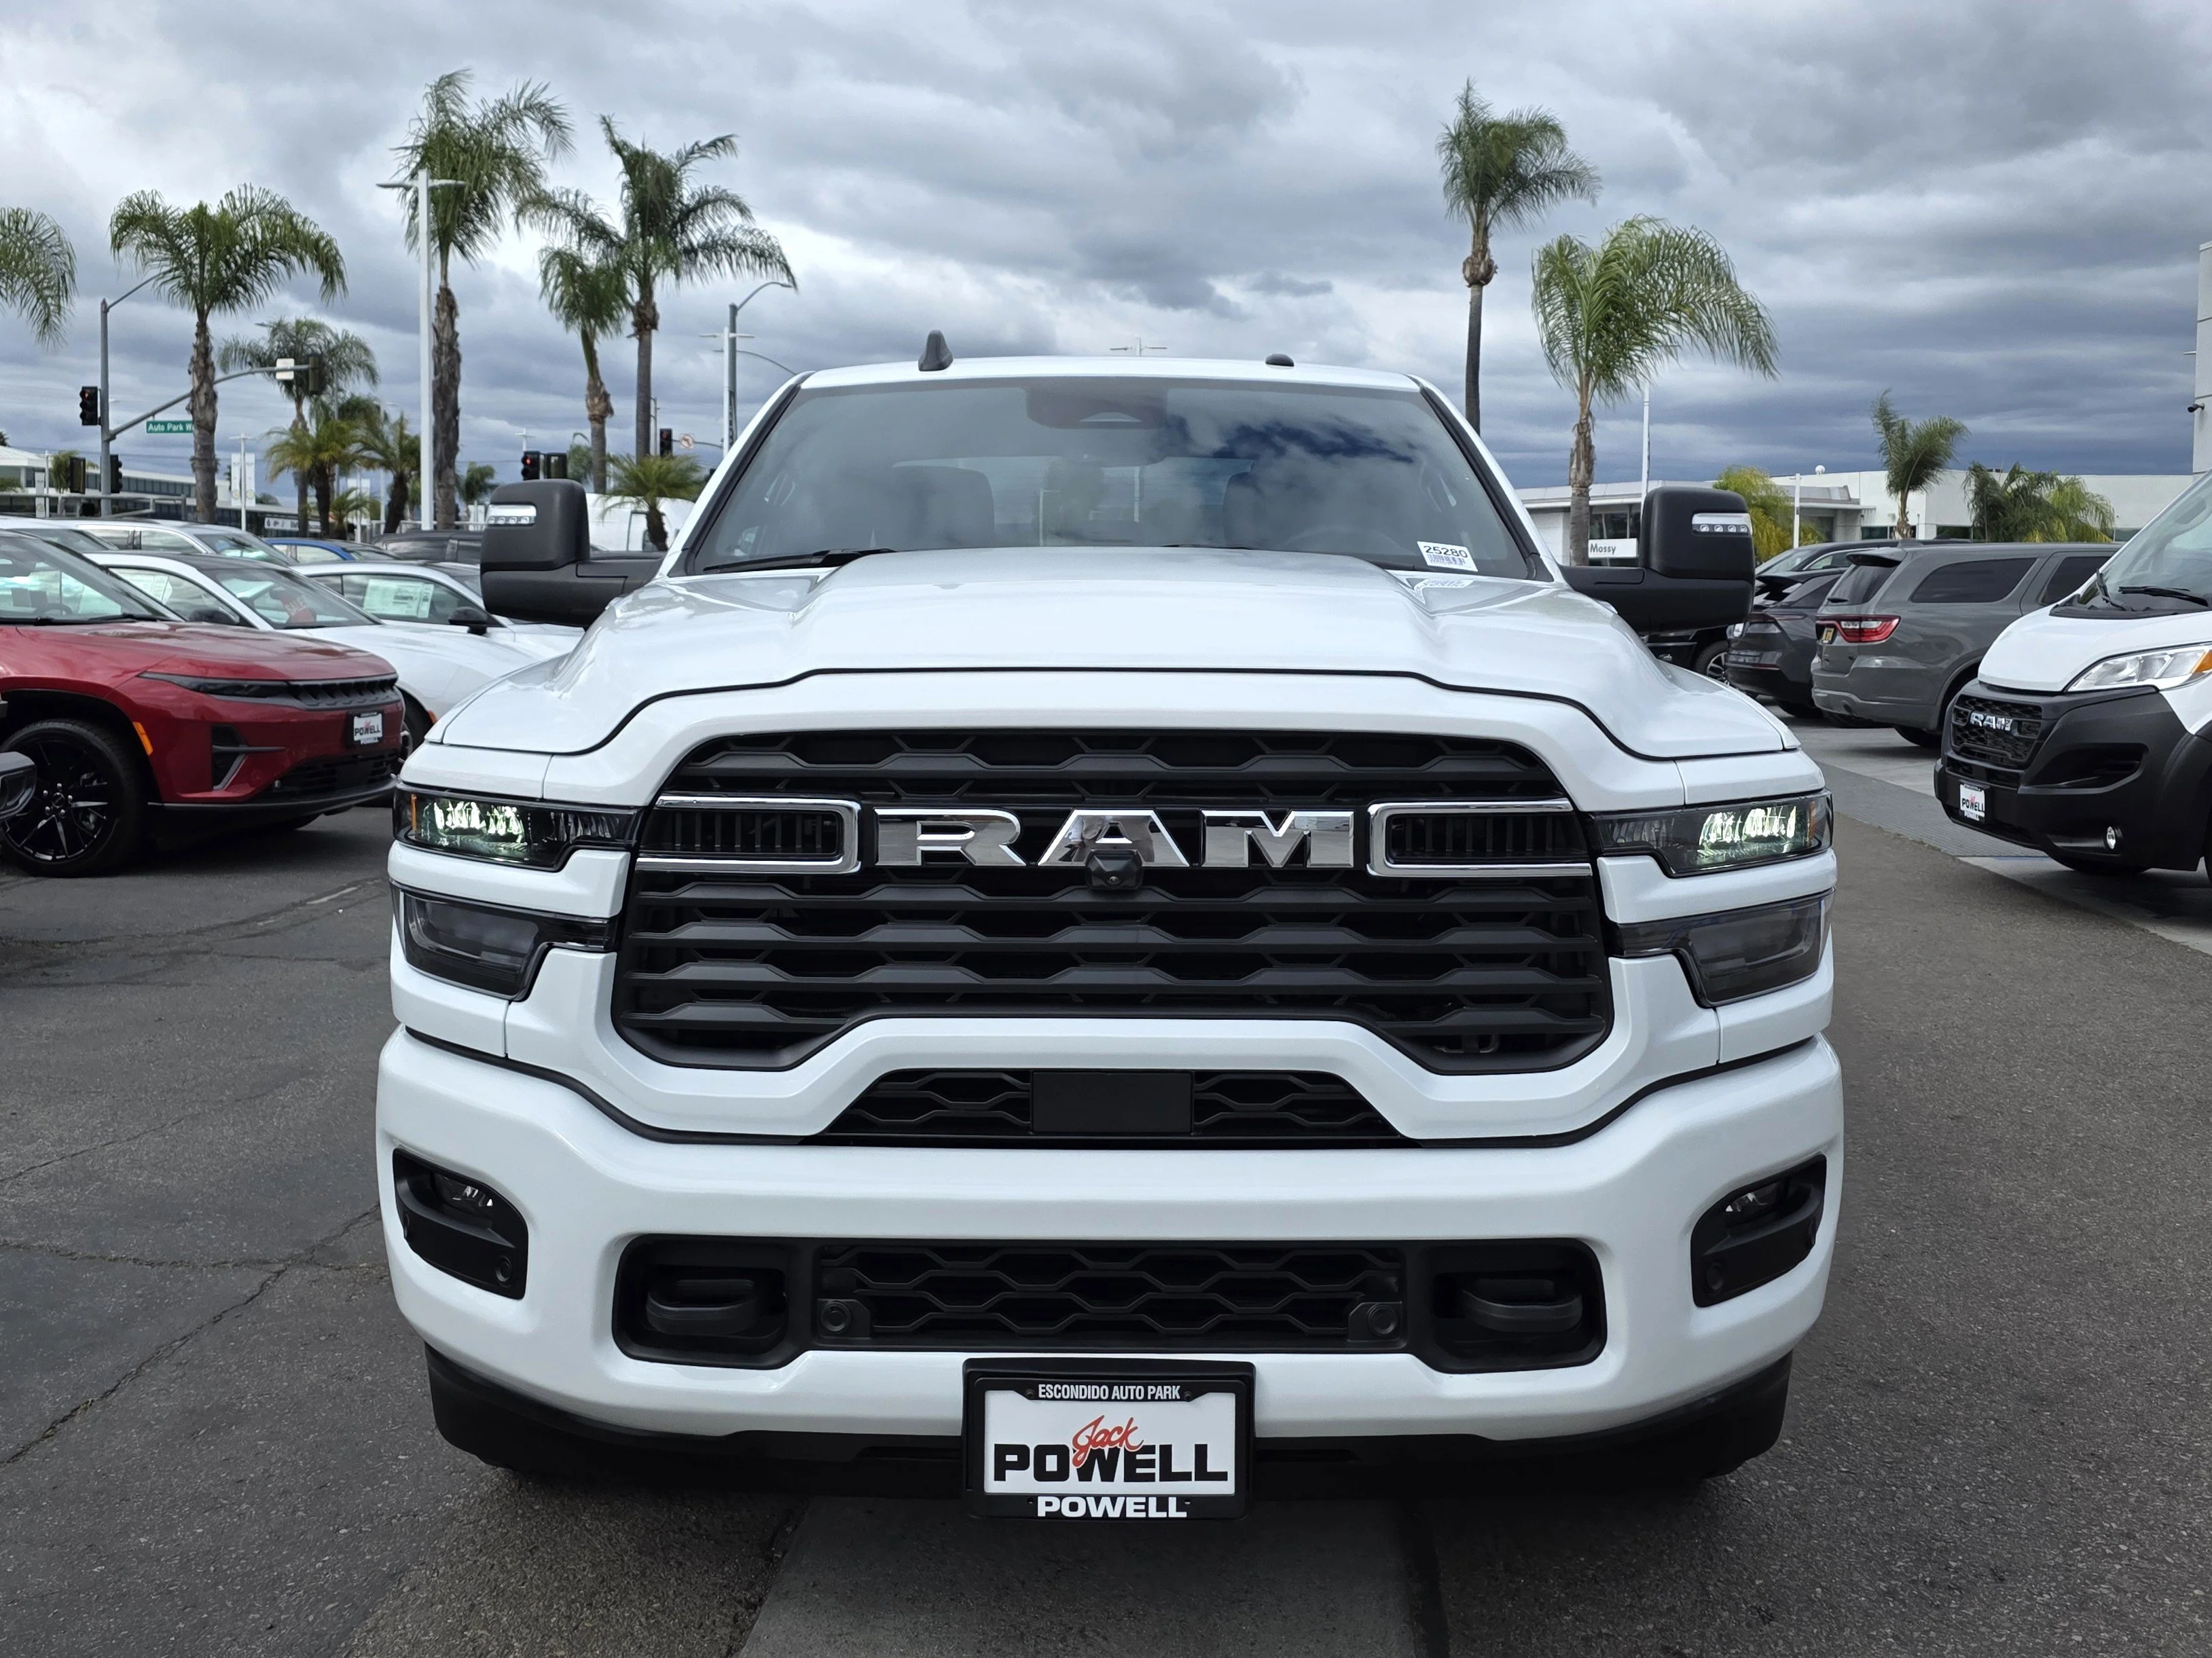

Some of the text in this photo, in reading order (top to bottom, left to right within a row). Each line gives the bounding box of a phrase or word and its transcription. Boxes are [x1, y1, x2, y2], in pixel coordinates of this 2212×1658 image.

[148, 423, 165, 431] Auto
[167, 422, 183, 431] Park
[1424, 545, 1468, 557] 25280
[1590, 543, 1616, 555] Mossy
[355, 724, 381, 736] POWELL
[1970, 712, 2013, 731] RAM
[874, 808, 1354, 867] RAM
[1038, 1384, 1180, 1400] ESCONDIDO AUTO PARK
[1072, 1415, 1144, 1469] Jack
[994, 1443, 1228, 1482] POWELL
[1037, 1496, 1187, 1518] POWELL
